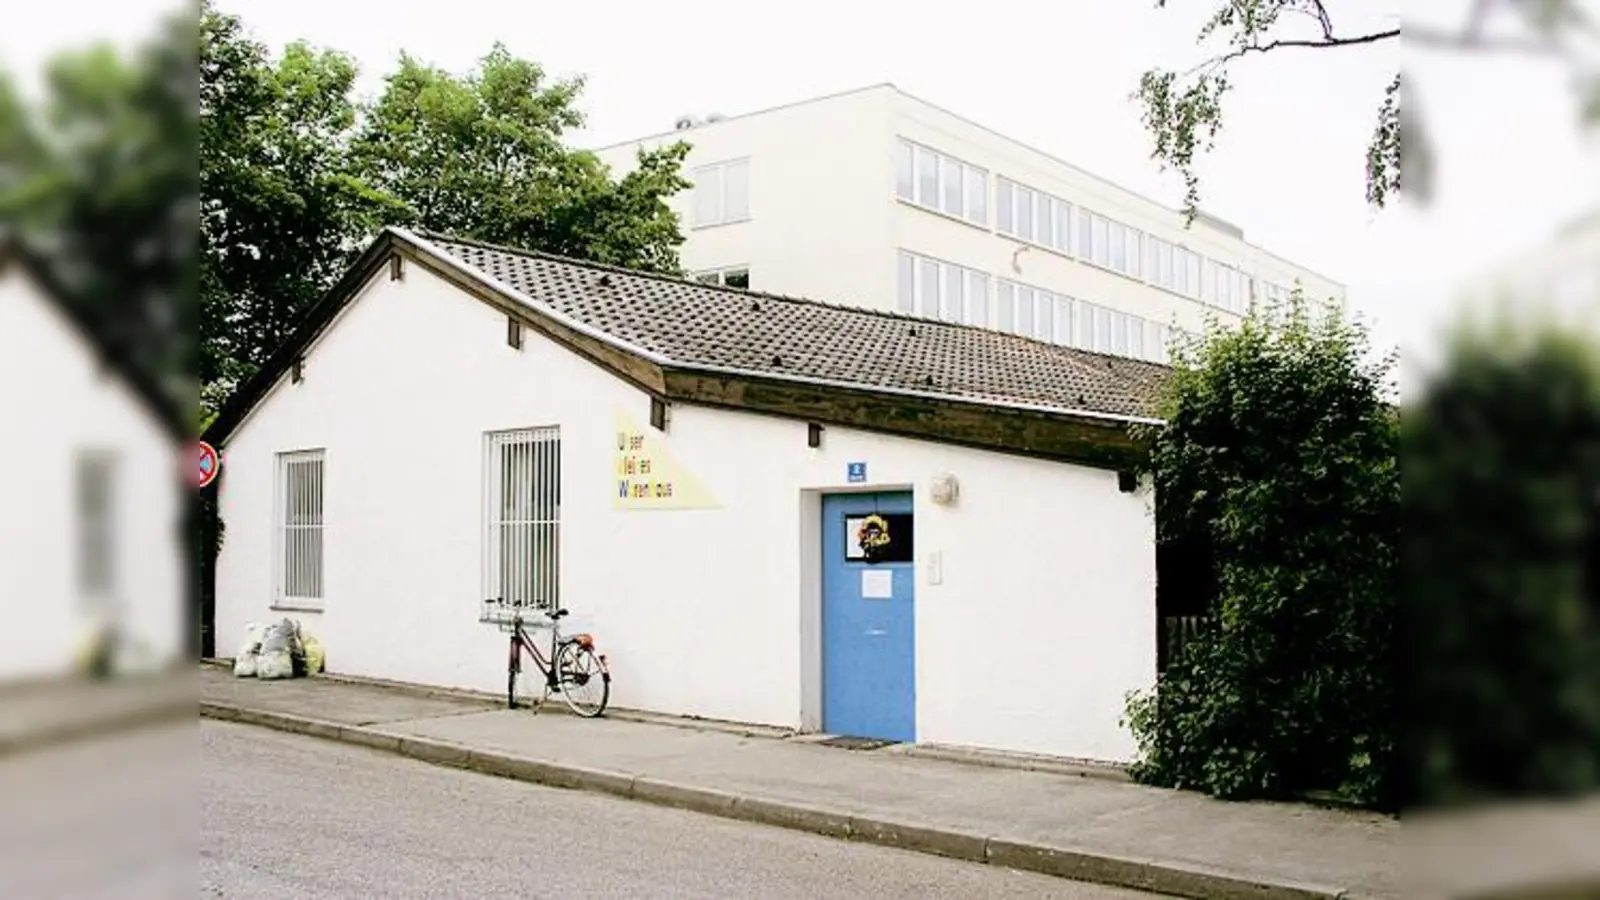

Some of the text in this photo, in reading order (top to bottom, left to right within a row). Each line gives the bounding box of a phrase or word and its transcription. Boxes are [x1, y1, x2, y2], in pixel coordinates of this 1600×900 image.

[617, 432, 644, 451] User
[617, 456, 651, 476] leies
[616, 480, 672, 498] Wrenaus
